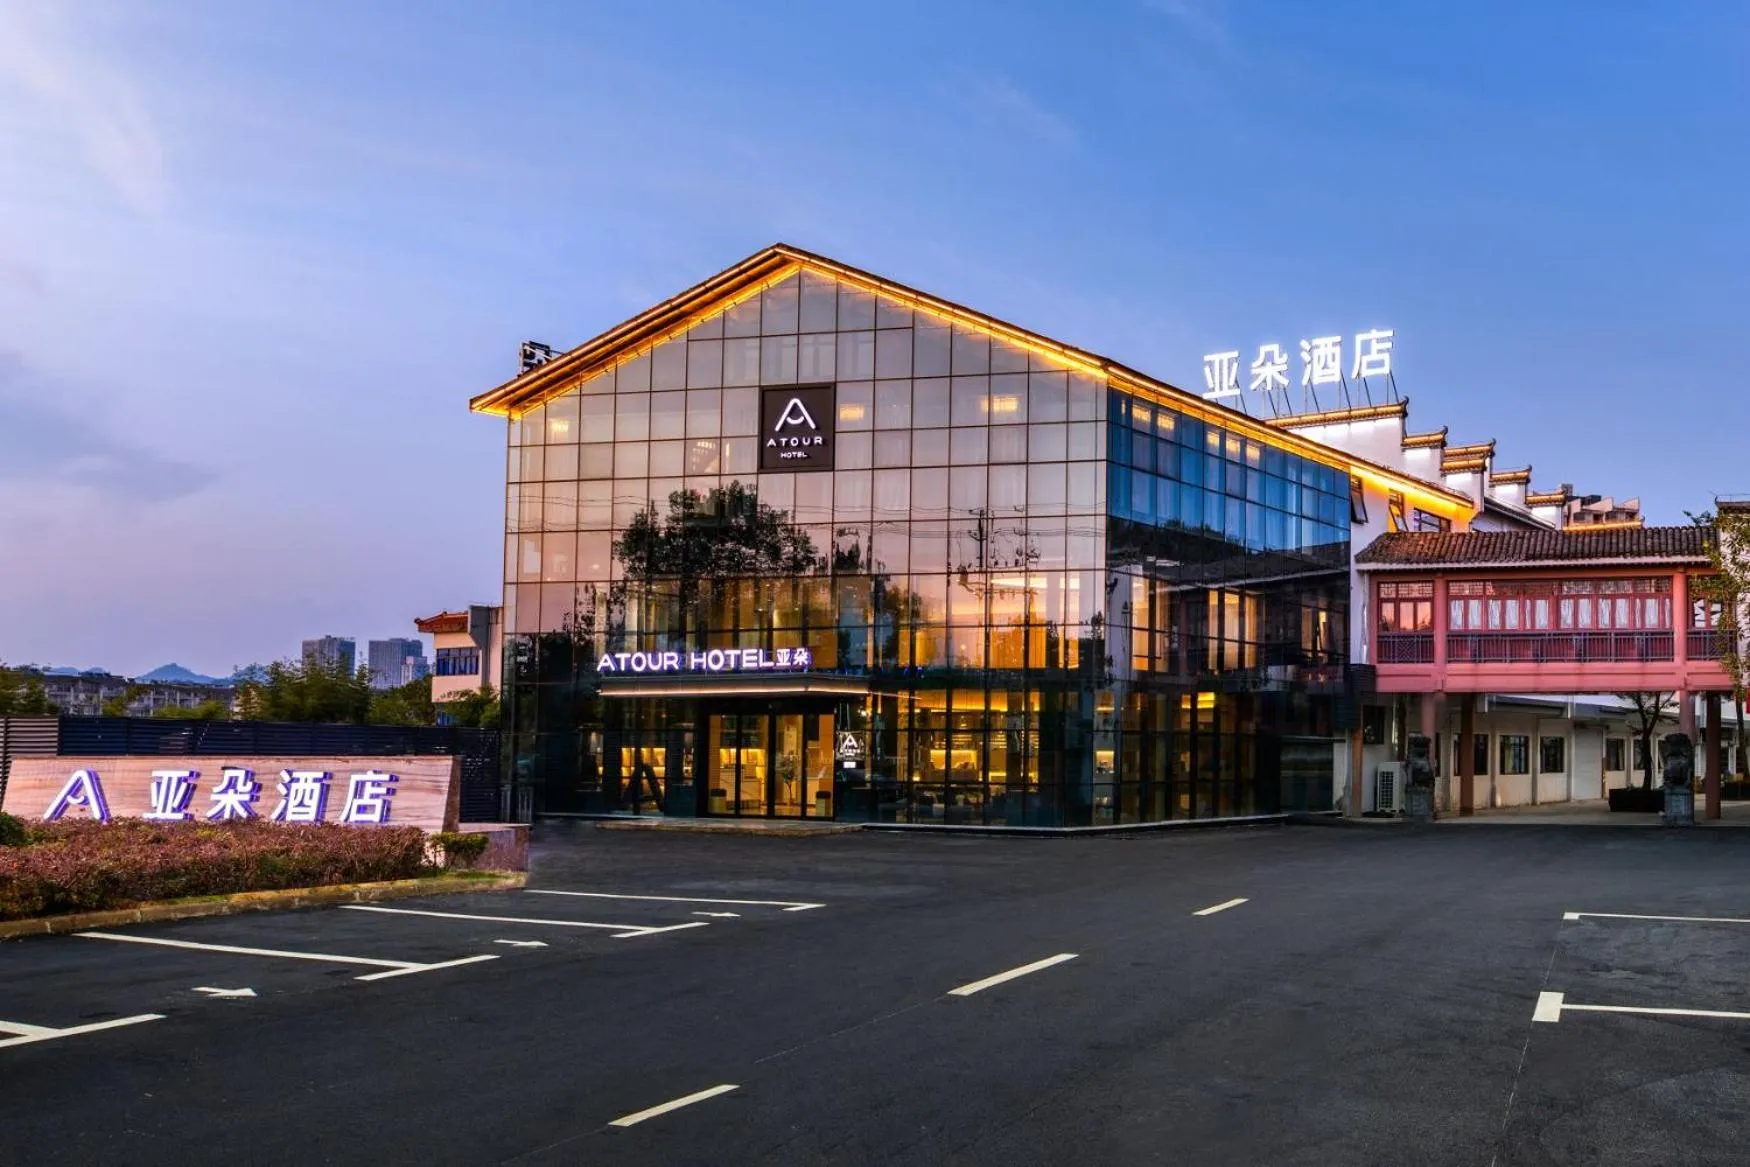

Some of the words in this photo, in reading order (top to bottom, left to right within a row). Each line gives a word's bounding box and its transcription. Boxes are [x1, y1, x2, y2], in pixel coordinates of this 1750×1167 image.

[1202, 329, 1394, 399] 亚朵酒店
[766, 436, 823, 447] ATOUR
[596, 652, 680, 671] ATOUR
[690, 649, 774, 671] HOTEL
[775, 647, 809, 666] 亚朵
[142, 768, 396, 823] 亚朵酒店
